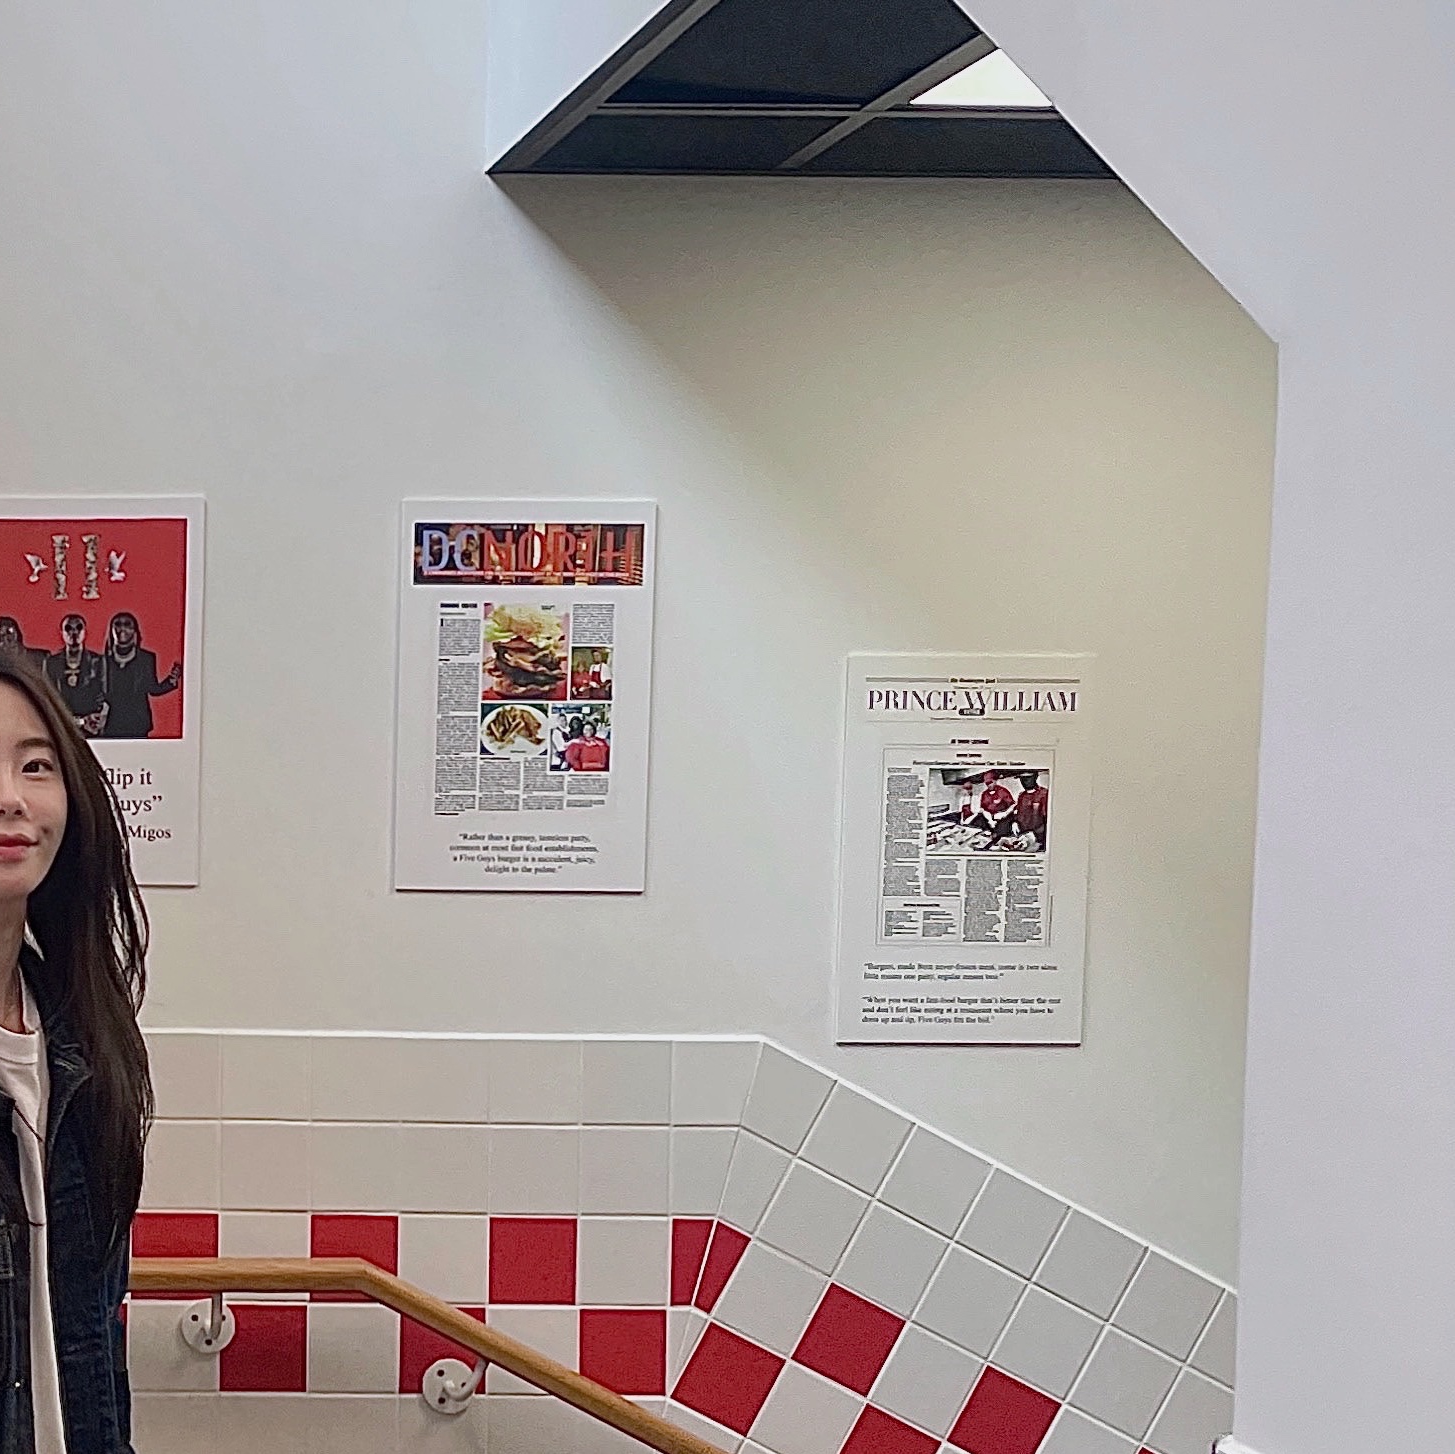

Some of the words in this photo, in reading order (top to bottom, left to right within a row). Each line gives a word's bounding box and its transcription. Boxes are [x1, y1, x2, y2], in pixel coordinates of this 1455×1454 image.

[868, 690, 957, 711] PRINCE
[964, 690, 1077, 712] WILLIAM
[140, 767, 152, 785] it
[117, 795, 162, 816] uys”
[477, 854, 495, 862] Guys
